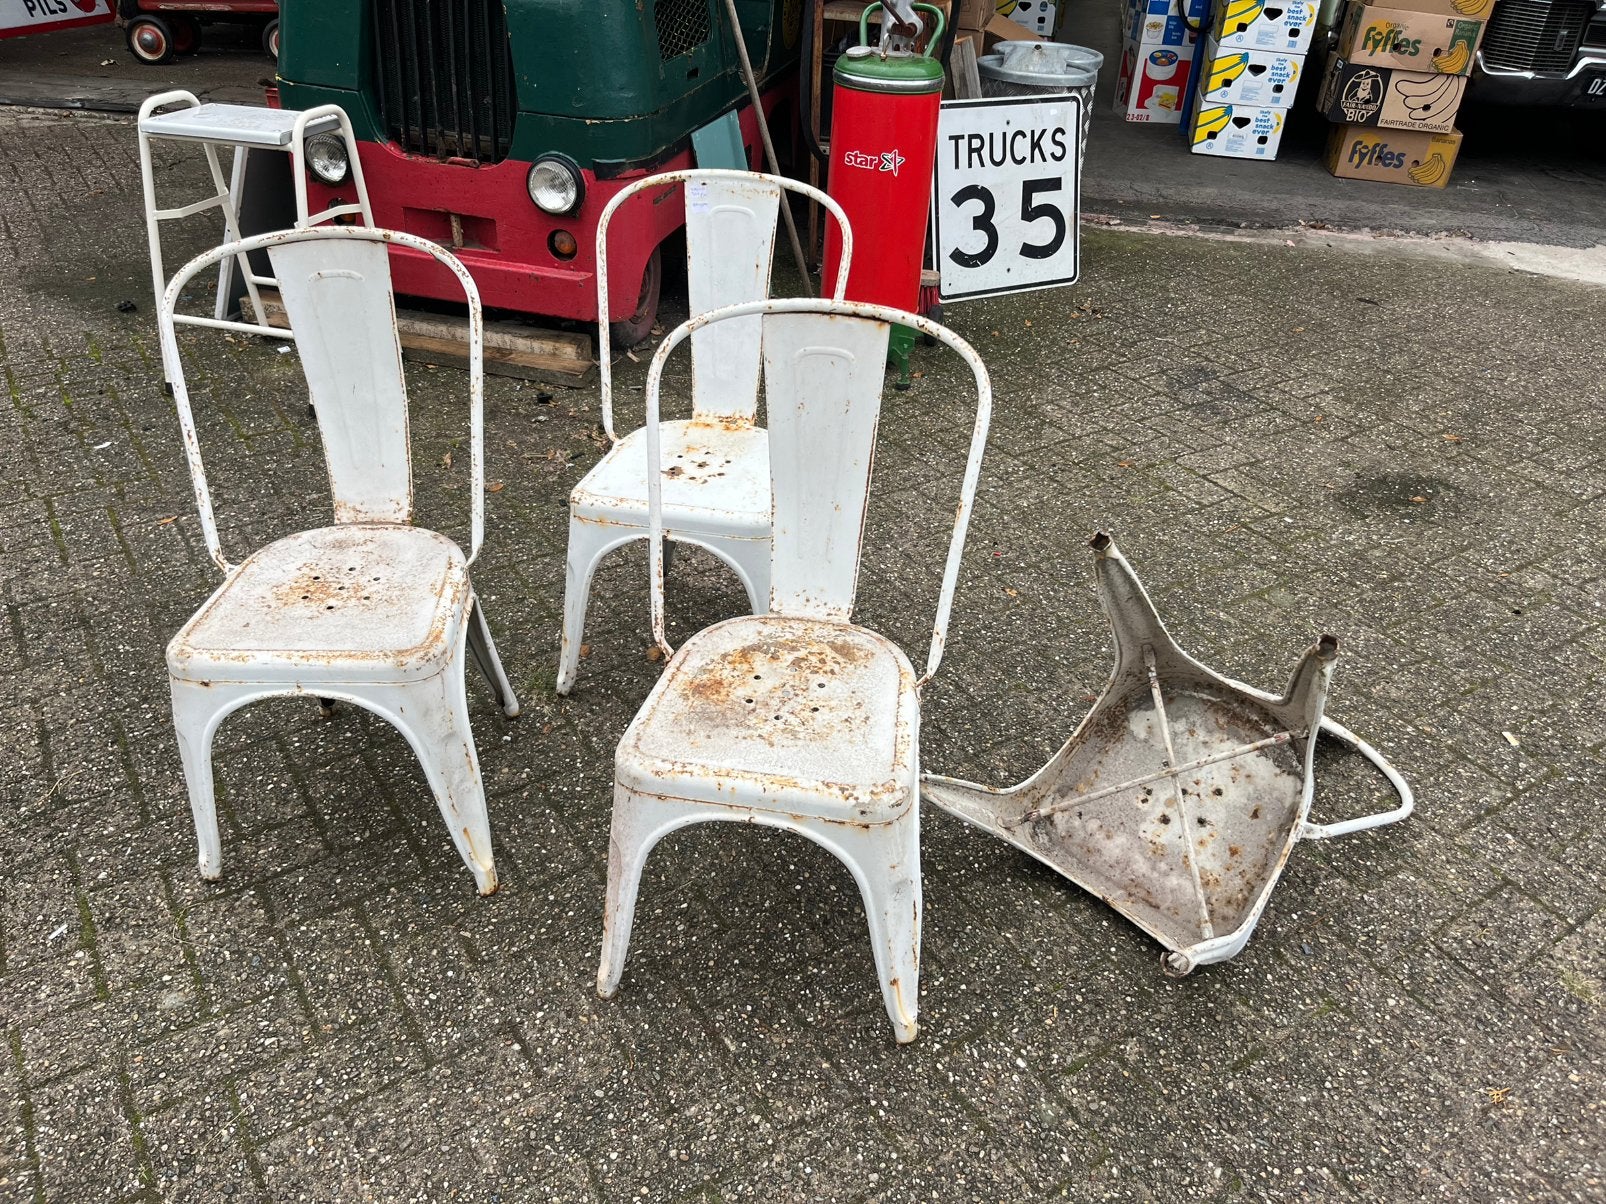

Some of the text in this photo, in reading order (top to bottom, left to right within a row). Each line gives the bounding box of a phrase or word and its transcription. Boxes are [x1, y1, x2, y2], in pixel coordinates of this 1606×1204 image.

[23, 0, 68, 17] PILS
[1287, 14, 1307, 22] snack
[1346, 109, 1367, 122] BIO
[1380, 118, 1450, 132] FAIRTRADE ORGANIC
[948, 126, 1067, 170] TRUCKS
[844, 150, 878, 170] star
[948, 176, 1067, 269] 35
